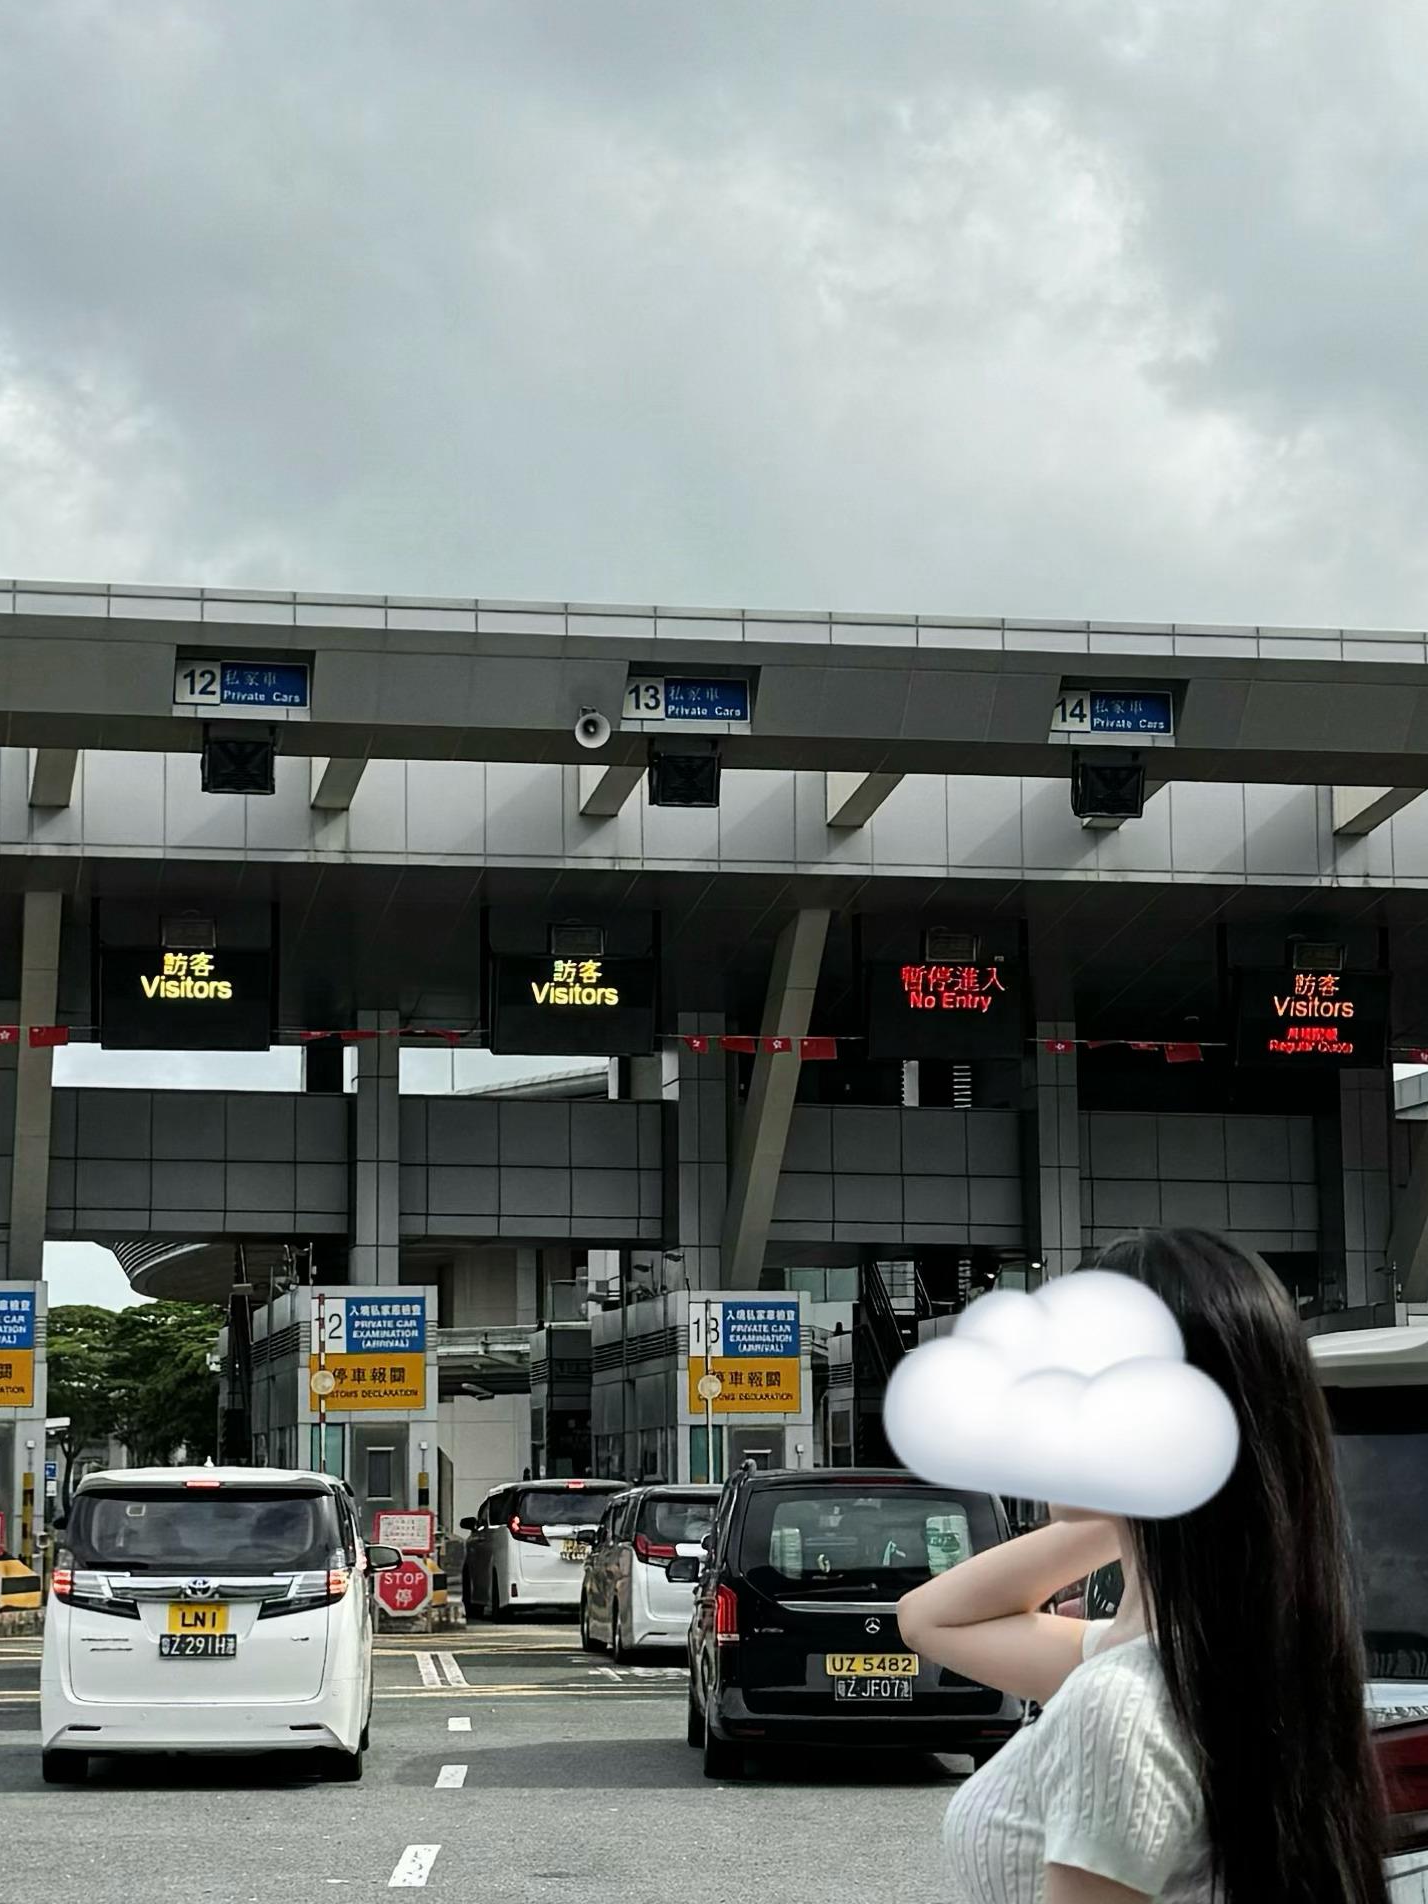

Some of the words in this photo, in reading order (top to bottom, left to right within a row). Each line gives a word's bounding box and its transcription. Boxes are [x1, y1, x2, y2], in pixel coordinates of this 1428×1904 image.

[183, 669, 217, 696] 12
[223, 690, 265, 702] Private
[272, 691, 300, 703] Cars
[627, 684, 661, 710] 13
[667, 705, 708, 716] Private
[715, 706, 741, 717] Cars
[1055, 698, 1087, 723] 14
[1093, 718, 1132, 729] Private
[1139, 719, 1165, 730] Cars
[163, 952, 215, 976] 訪客
[553, 959, 602, 984] 訪客
[140, 976, 233, 999] Visitors
[900, 966, 1006, 993] 暫停進入
[1294, 973, 1340, 997] 訪客
[531, 982, 619, 1006] Visitors
[909, 993, 935, 1009] No
[941, 993, 992, 1013] Entry
[1273, 996, 1354, 1018] Visitors
[3, 1315, 25, 1324] CAR
[354, 1320, 394, 1329] PRIVATE
[396, 1320, 417, 1329] CAR
[352, 1329, 419, 1338] EXAMINATION
[692, 1317, 720, 1344] 13
[730, 1324, 769, 1333] PRIVATE
[771, 1324, 791, 1333] CAR
[361, 1338, 409, 1348] (ARRIVAL)
[728, 1334, 792, 1343] EXAMINATION
[737, 1343, 784, 1352] (ARRIVAL)
[332, 1367, 405, 1384] 停車報關
[361, 1388, 418, 1397] DECLARATION
[739, 1393, 793, 1401] DECLARATION
[384, 1572, 424, 1585] STOP
[181, 1611, 206, 1628] LN
[211, 1611, 217, 1627] 1
[832, 1657, 857, 1673] UZ
[862, 1657, 912, 1673] 5482
